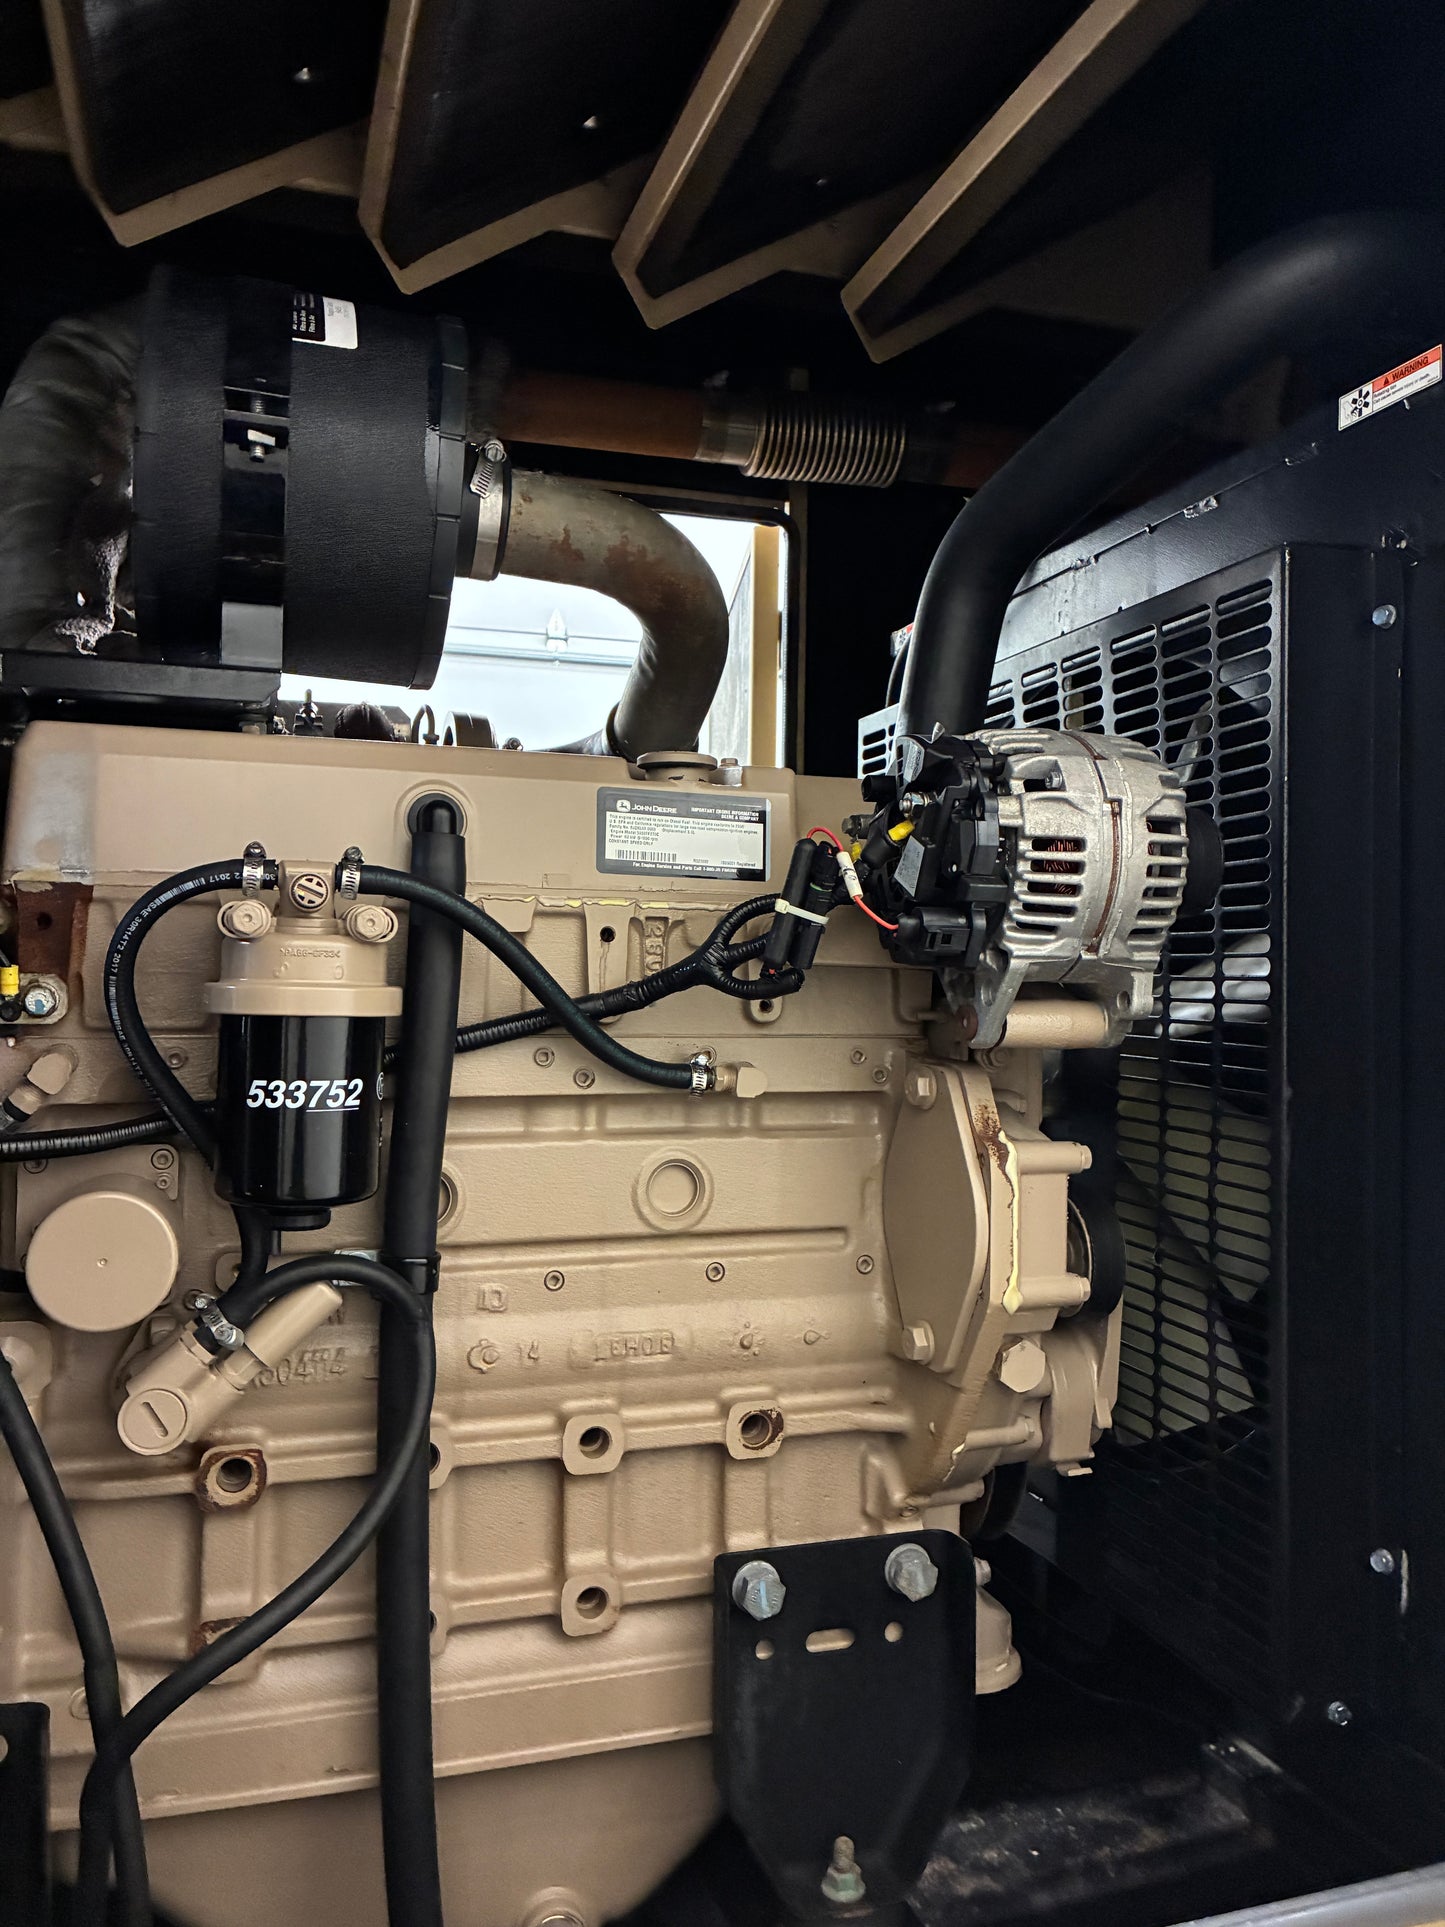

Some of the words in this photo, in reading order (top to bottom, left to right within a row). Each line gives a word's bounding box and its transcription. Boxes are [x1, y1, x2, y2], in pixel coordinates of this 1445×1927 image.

[1392, 356, 1428, 380] WARNING
[632, 804, 652, 812] JOHN
[653, 806, 677, 814] DEERE
[209, 873, 230, 883] 2017
[140, 902, 157, 918] SAE
[117, 916, 142, 950] 30R14T2
[111, 953, 121, 973] 2017
[246, 1078, 363, 1109] 533752
